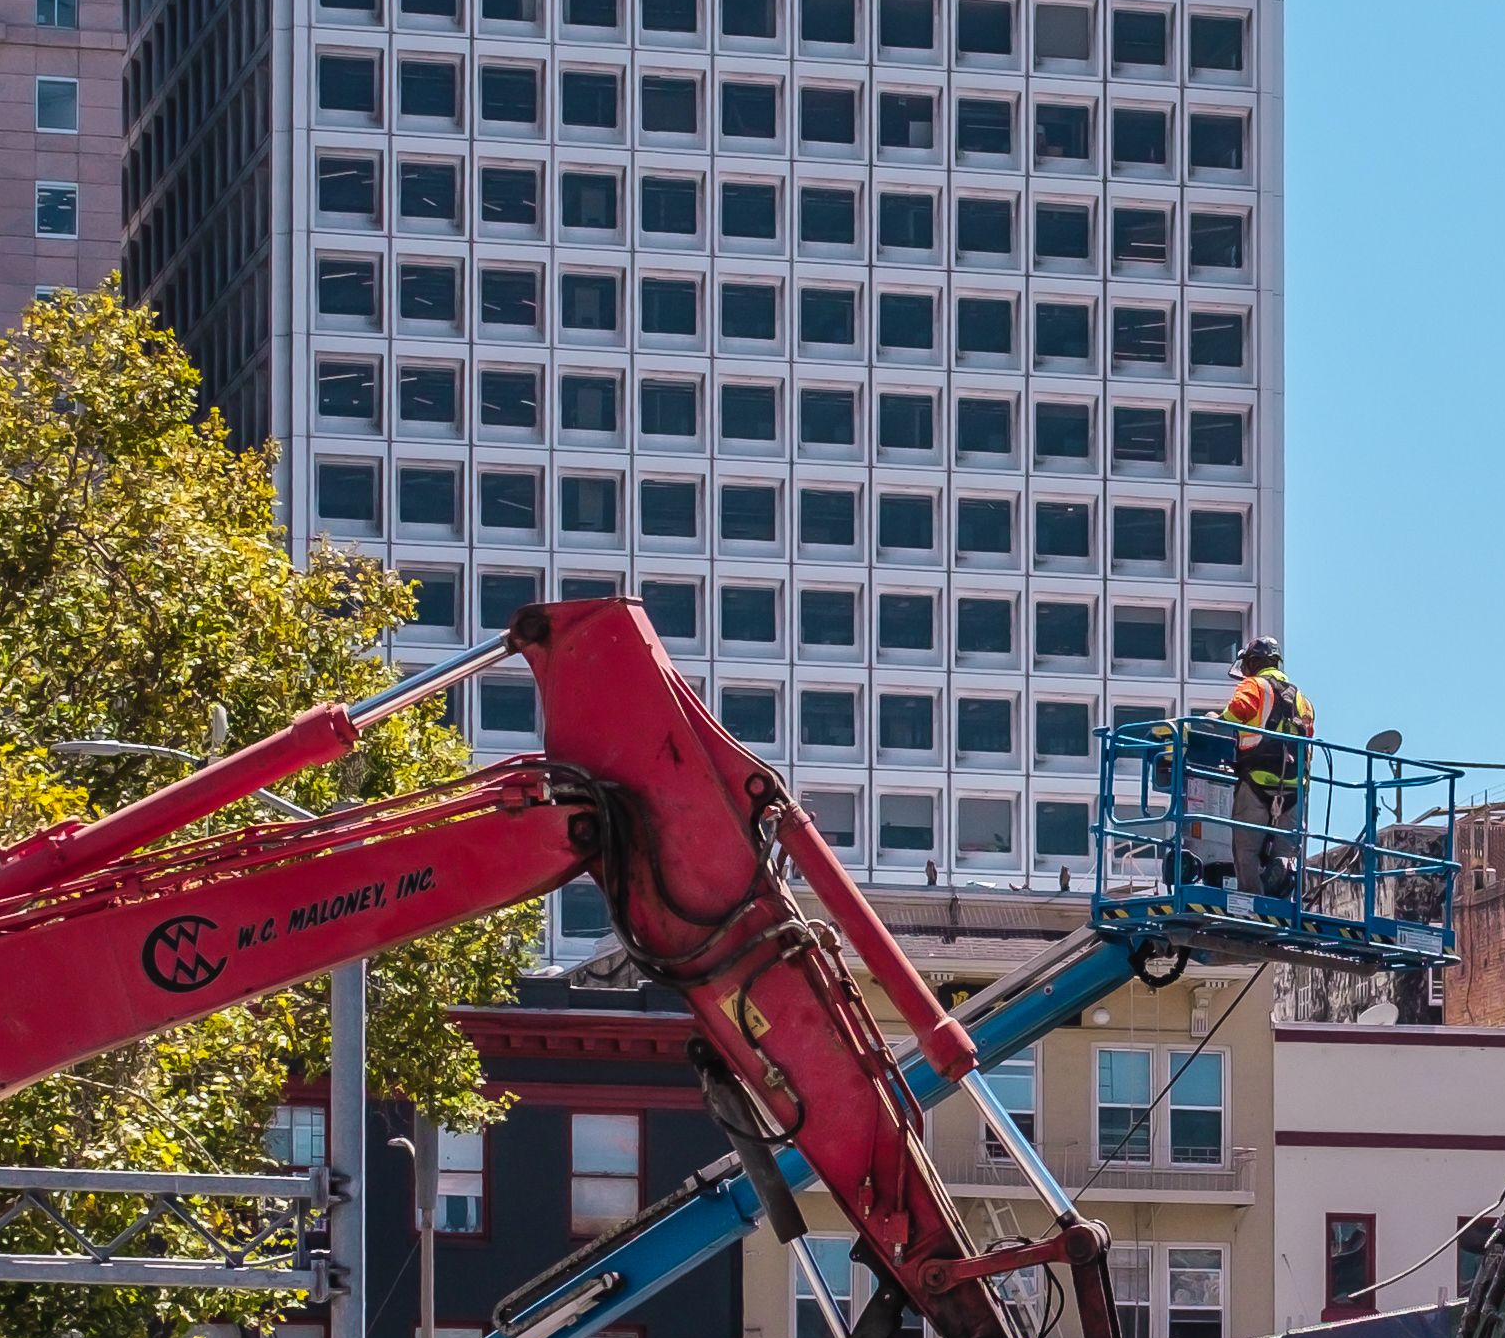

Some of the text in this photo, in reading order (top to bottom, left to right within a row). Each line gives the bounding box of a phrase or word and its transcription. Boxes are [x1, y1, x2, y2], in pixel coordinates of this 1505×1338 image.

[238, 866, 437, 951] W.C. MALONEY, INC.
